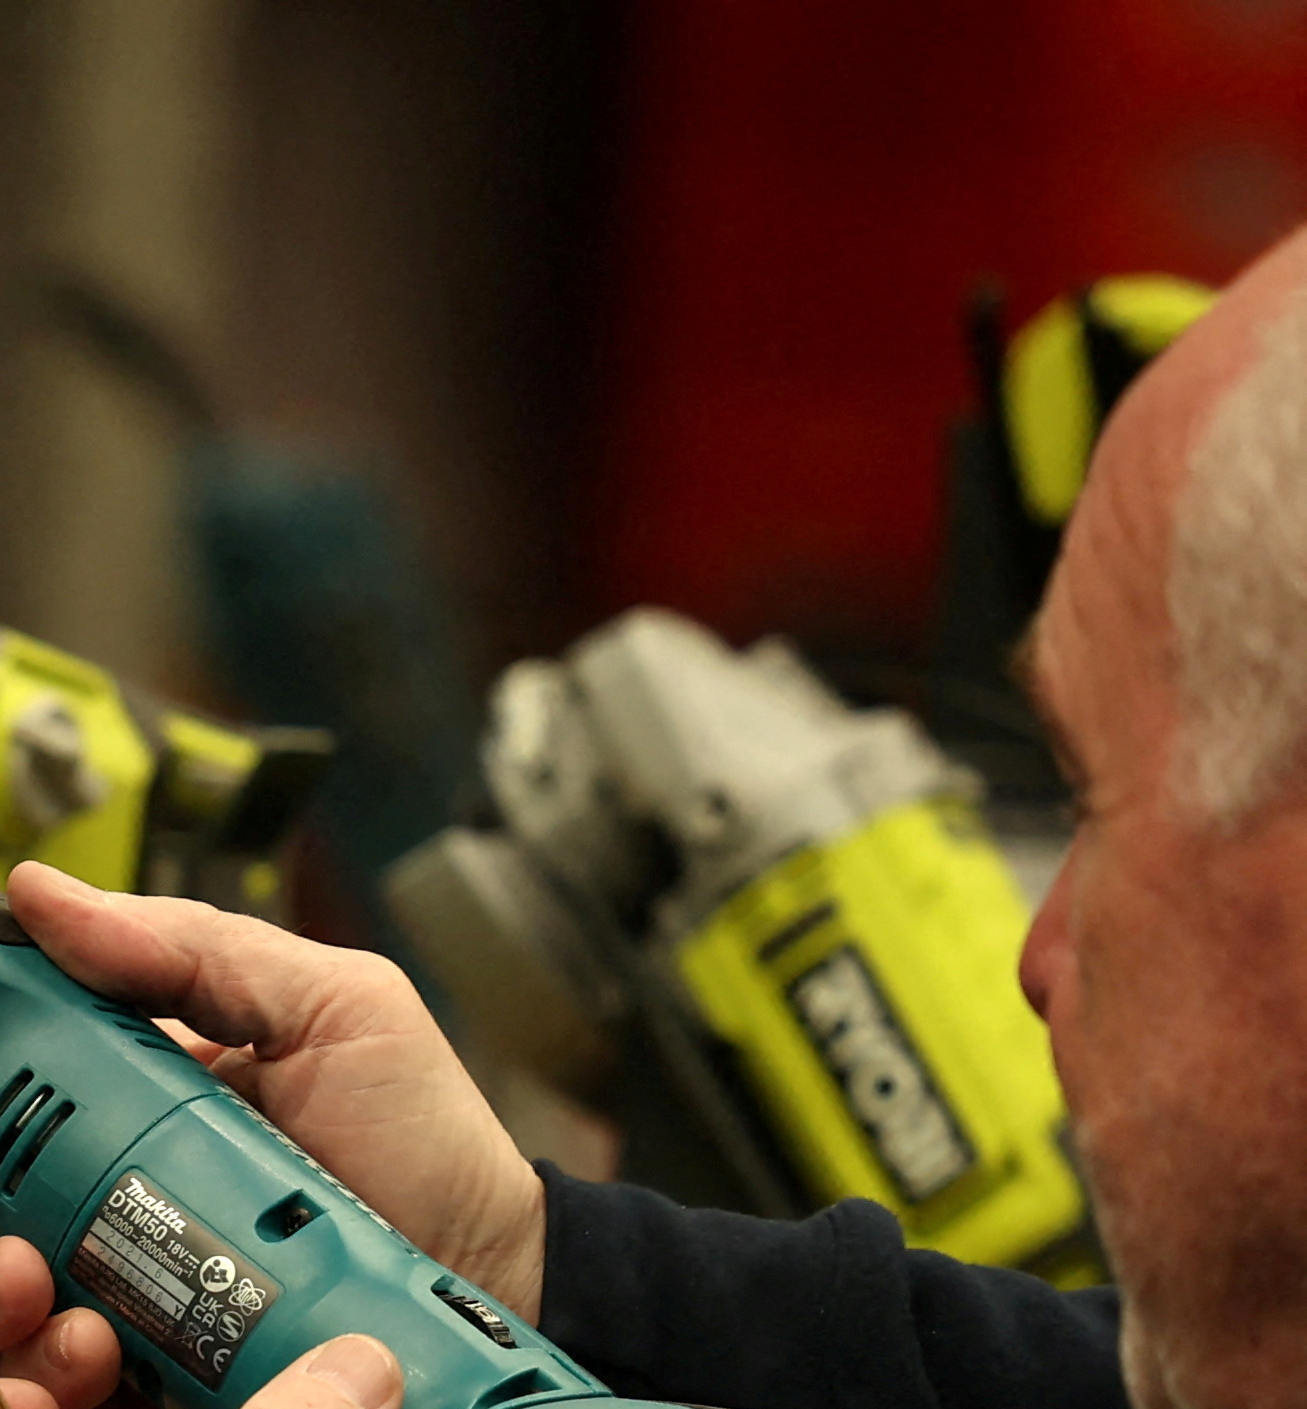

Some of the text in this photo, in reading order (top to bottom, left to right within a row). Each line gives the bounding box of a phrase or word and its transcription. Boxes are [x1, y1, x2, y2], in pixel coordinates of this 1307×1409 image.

[108, 1189, 168, 1241] DTM50
[125, 1177, 187, 1234] Makita
[199, 1291, 224, 1316] UK
